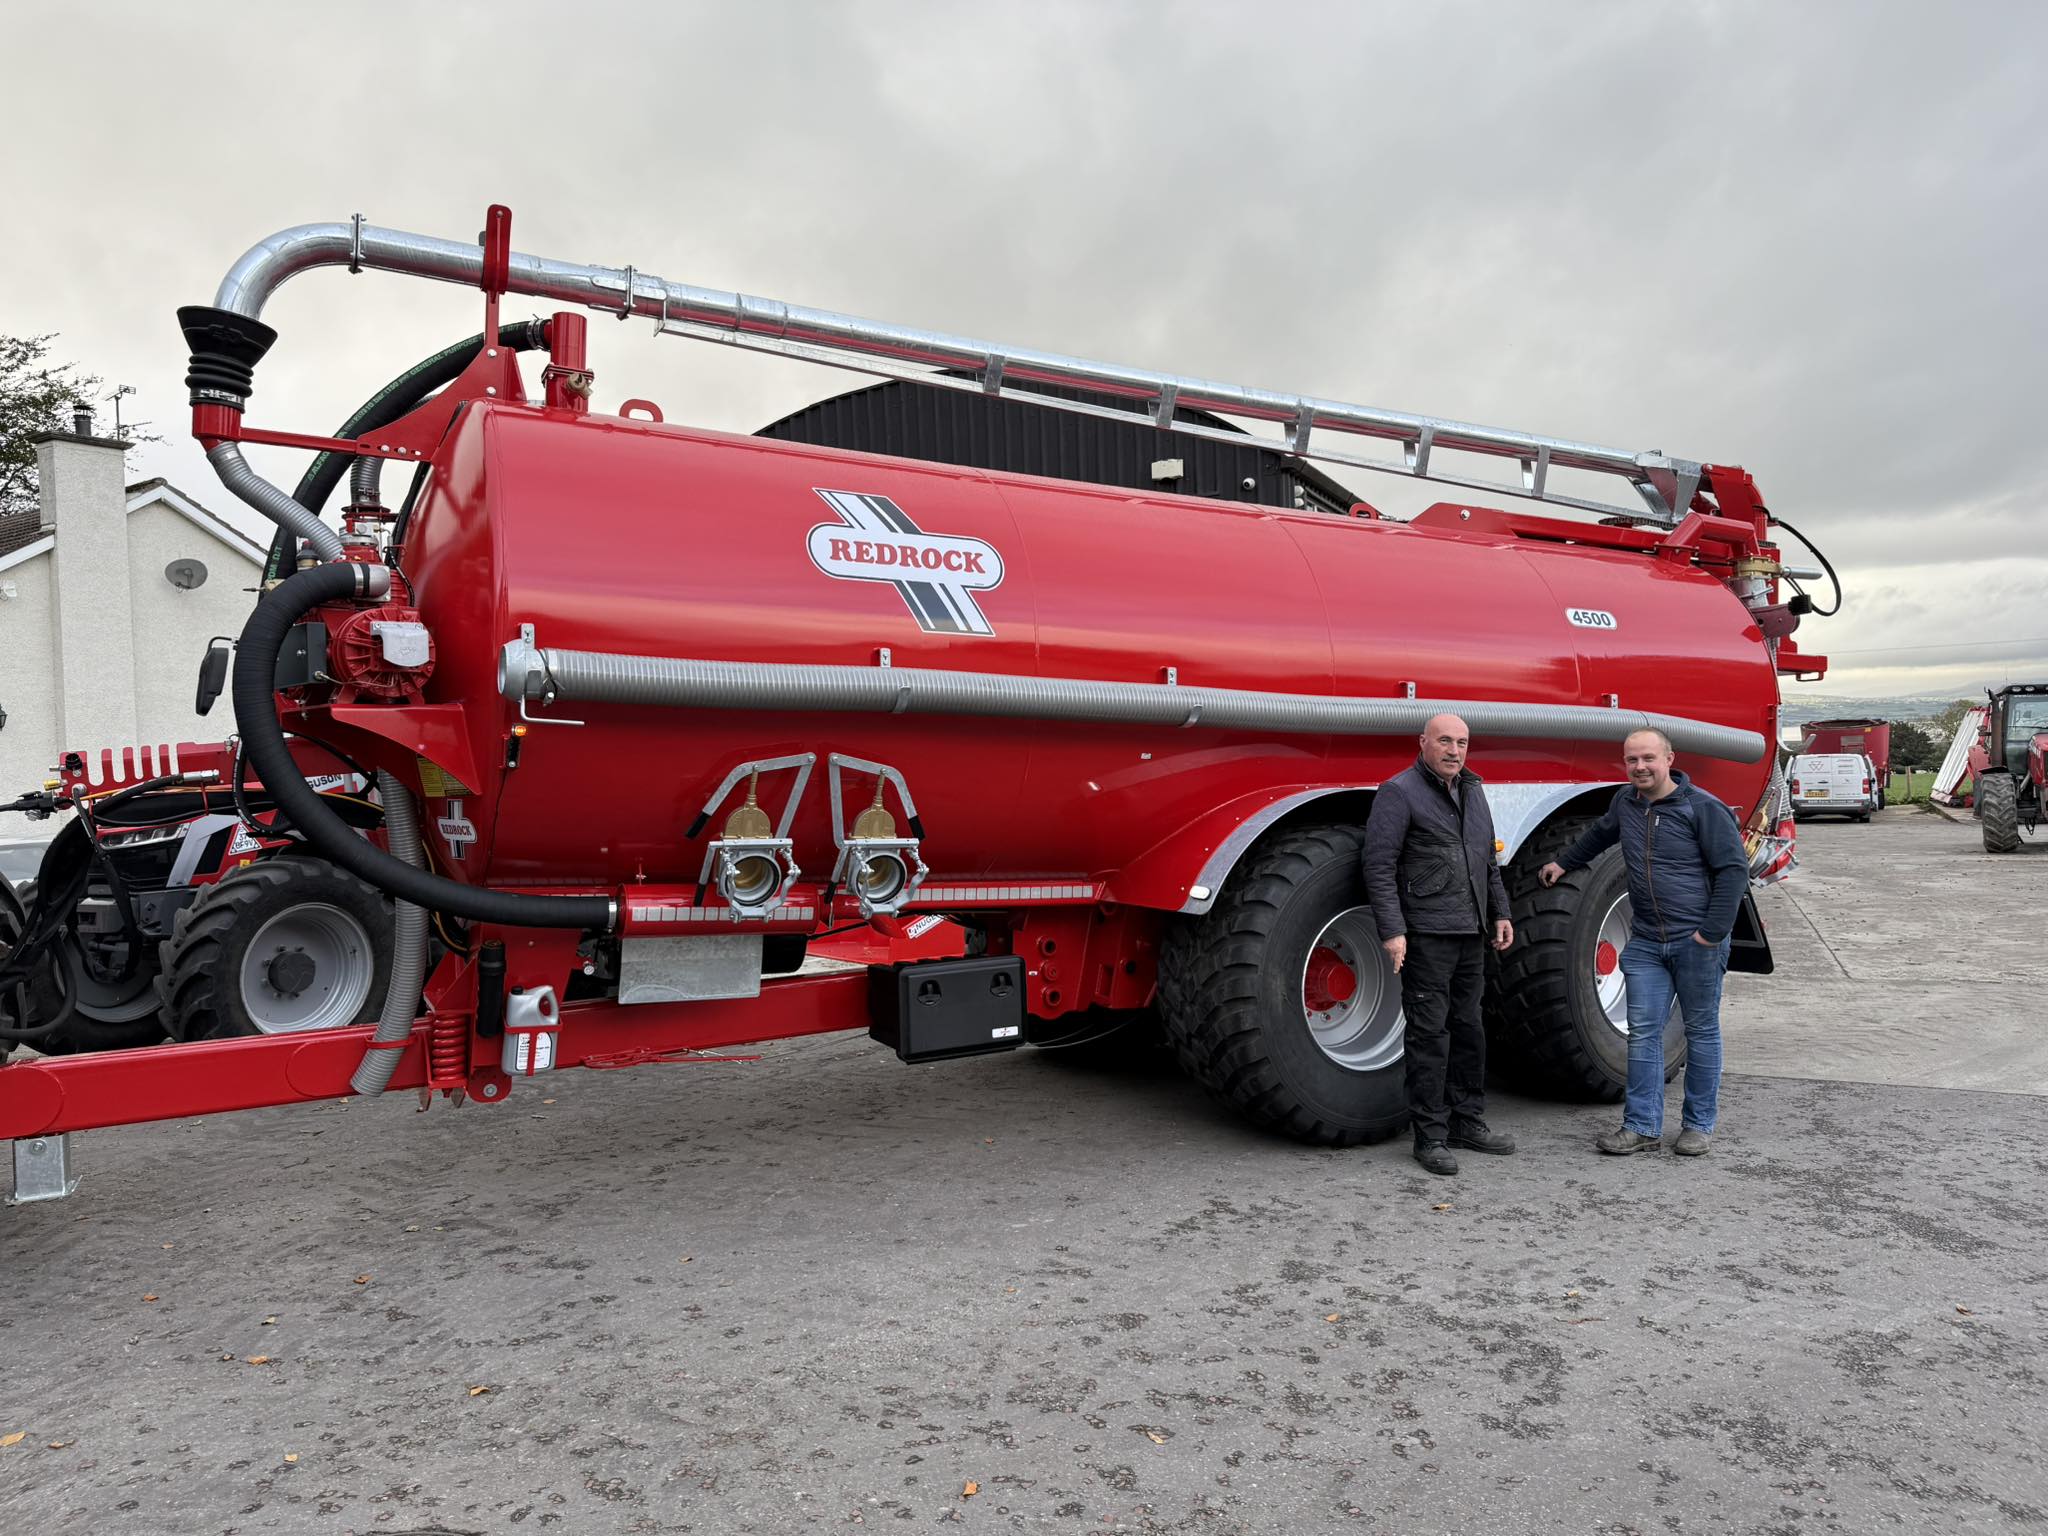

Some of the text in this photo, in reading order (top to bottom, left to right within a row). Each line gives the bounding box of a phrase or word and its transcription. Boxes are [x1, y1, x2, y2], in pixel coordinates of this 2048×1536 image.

[410, 353, 445, 376] GENERAL
[444, 337, 478, 357] PURPOSE
[829, 538, 986, 574] REDROCK
[1573, 610, 1611, 626] 4500
[308, 774, 342, 789] GUSON
[441, 823, 472, 836] REDROCK
